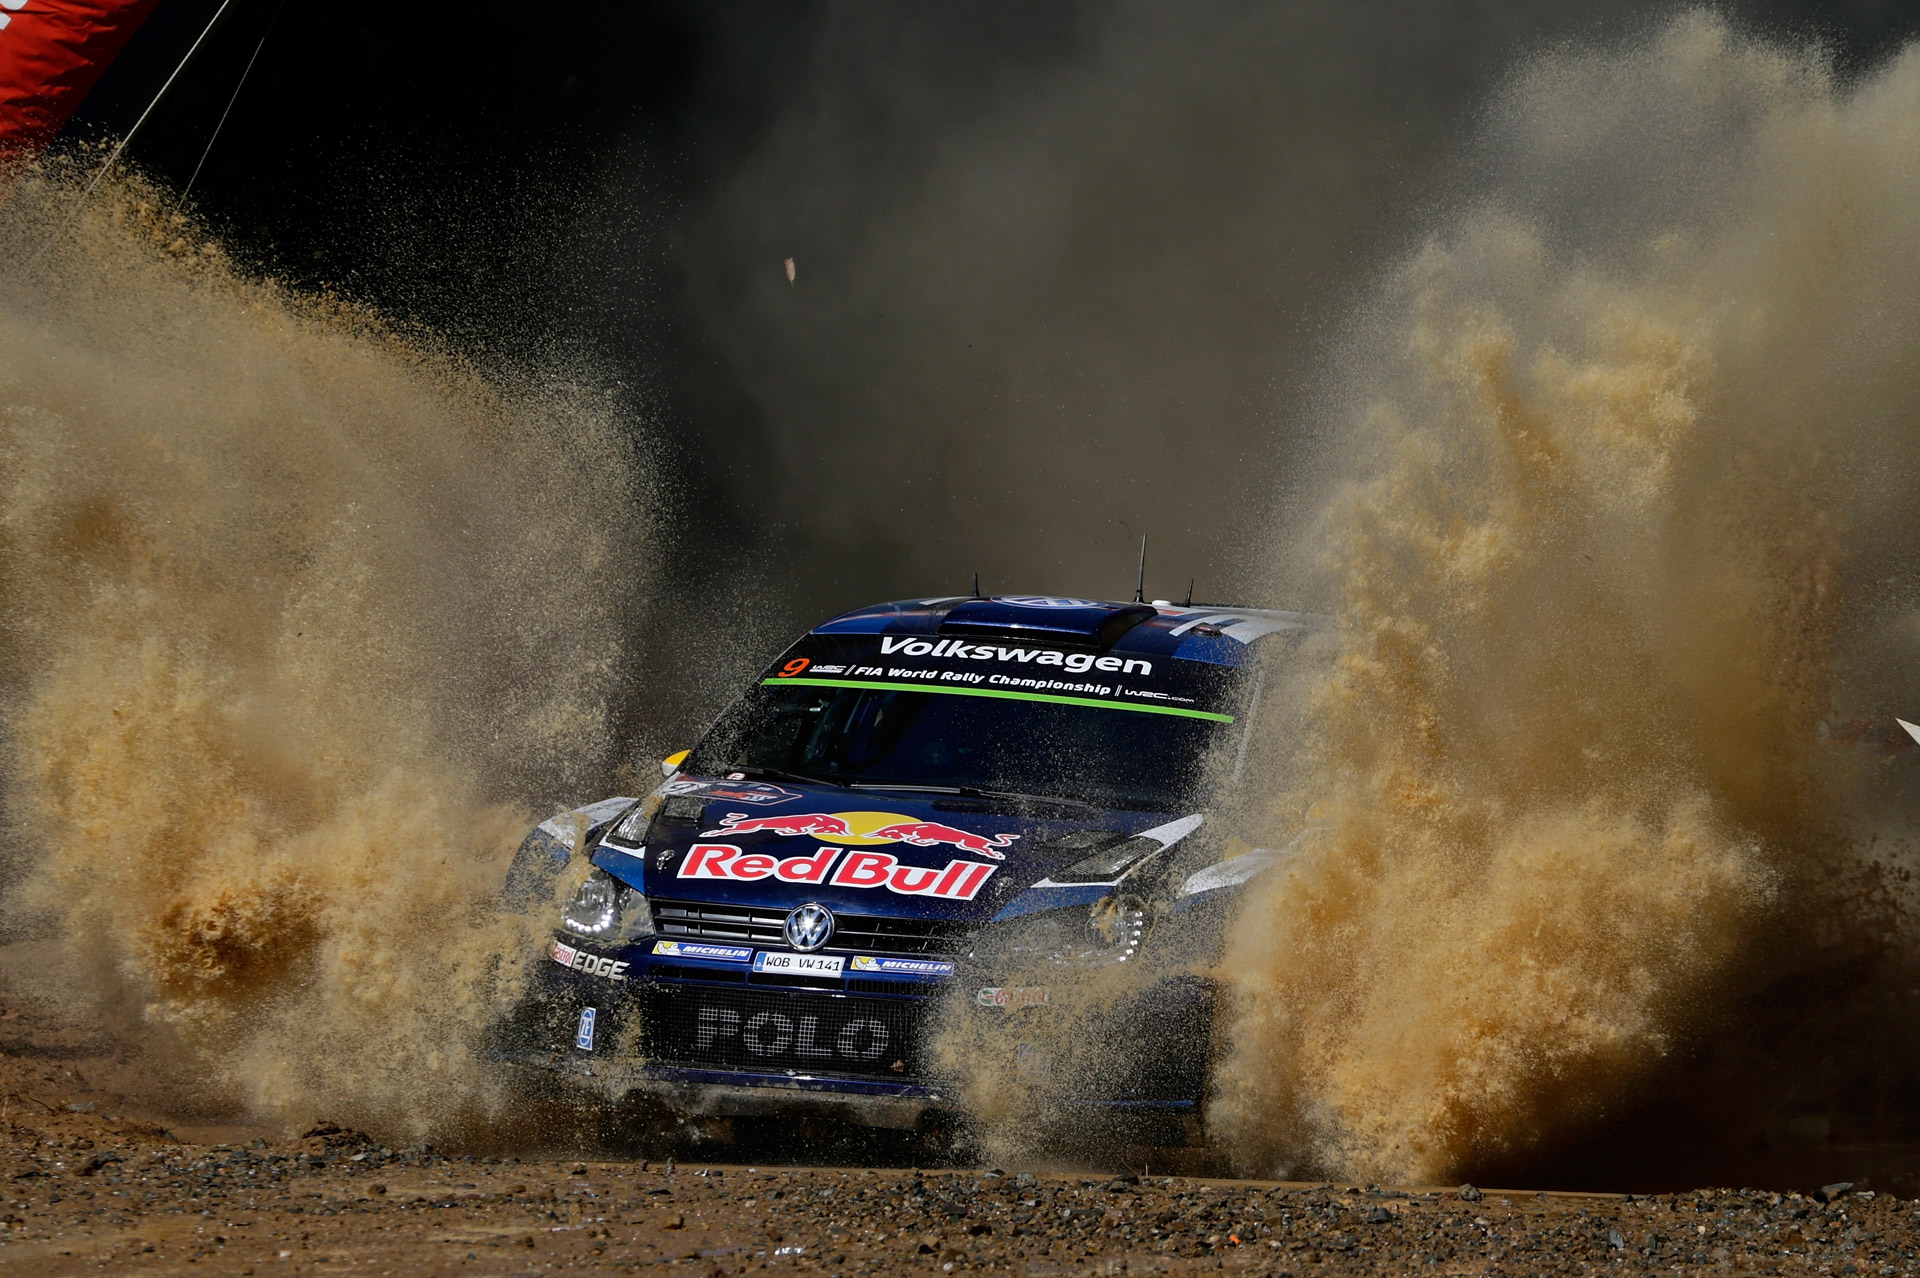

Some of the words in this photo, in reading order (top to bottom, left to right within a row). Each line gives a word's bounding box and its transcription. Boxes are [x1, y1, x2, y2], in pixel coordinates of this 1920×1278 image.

[778, 658, 810, 677] 9
[880, 636, 1152, 676] Volkswagen
[854, 666, 883, 676] FIA
[888, 668, 936, 679] World
[940, 671, 985, 684] Rally
[988, 674, 1112, 695] Championship
[678, 845, 842, 883] Red
[830, 850, 997, 900] Bull
[572, 951, 631, 980] EDGE
[682, 945, 750, 957] MICHELIN
[766, 956, 790, 967] WOB
[882, 960, 952, 972] MICHELIN
[697, 1005, 889, 1061] POLO
